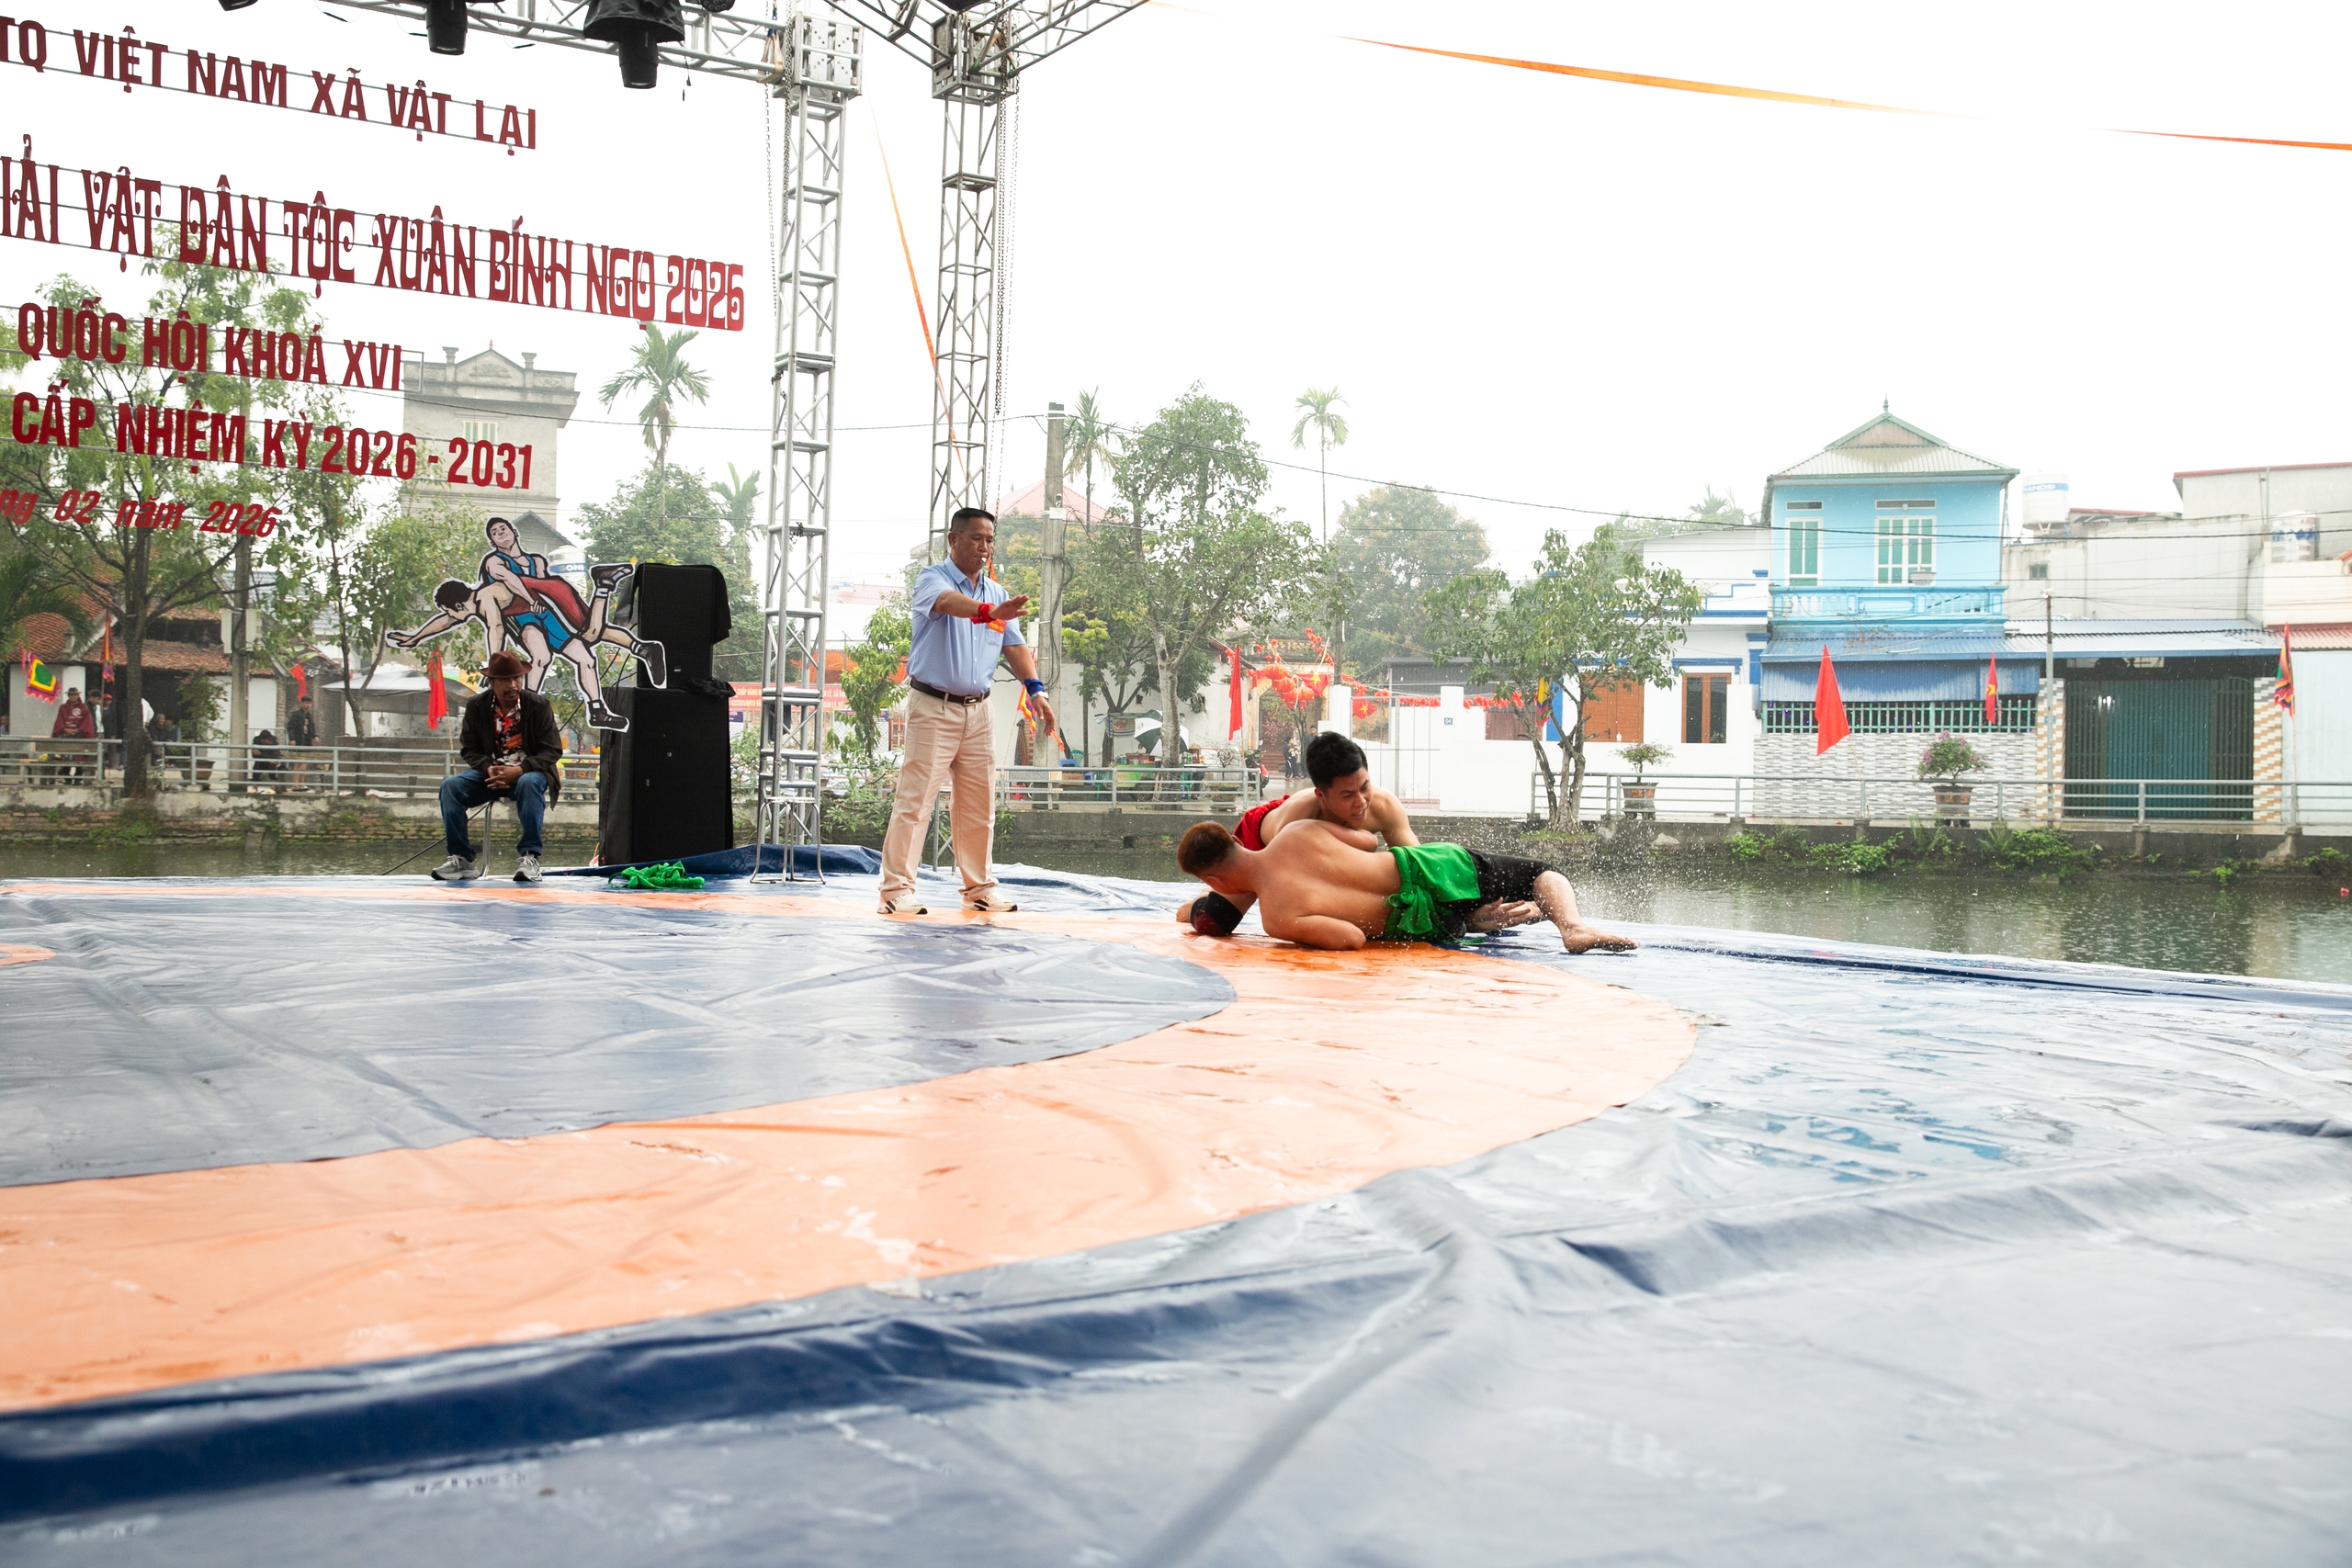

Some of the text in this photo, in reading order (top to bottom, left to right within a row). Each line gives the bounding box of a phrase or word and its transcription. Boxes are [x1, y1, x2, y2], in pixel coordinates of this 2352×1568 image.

[74, 26, 168, 94] VIỆT
[187, 51, 288, 109] NAM
[311, 68, 367, 121] XÃ
[388, 80, 451, 141] VẬT
[476, 101, 536, 156] LẠI
[81, 166, 162, 273] VẬT
[178, 175, 268, 274] DÂN
[284, 191, 356, 299] TỘC
[374, 205, 477, 298] XUÂN
[489, 216, 573, 310] BÍNH
[585, 243, 655, 331] NGỌ
[665, 255, 744, 332] 2026
[17, 296, 401, 391] QUỐC HỘI KHOÁ XVI
[12, 378, 532, 490] CẤP NHIỆM KỲ 2026 - 2031
[0, 483, 281, 538] ng 02 năm 2026
